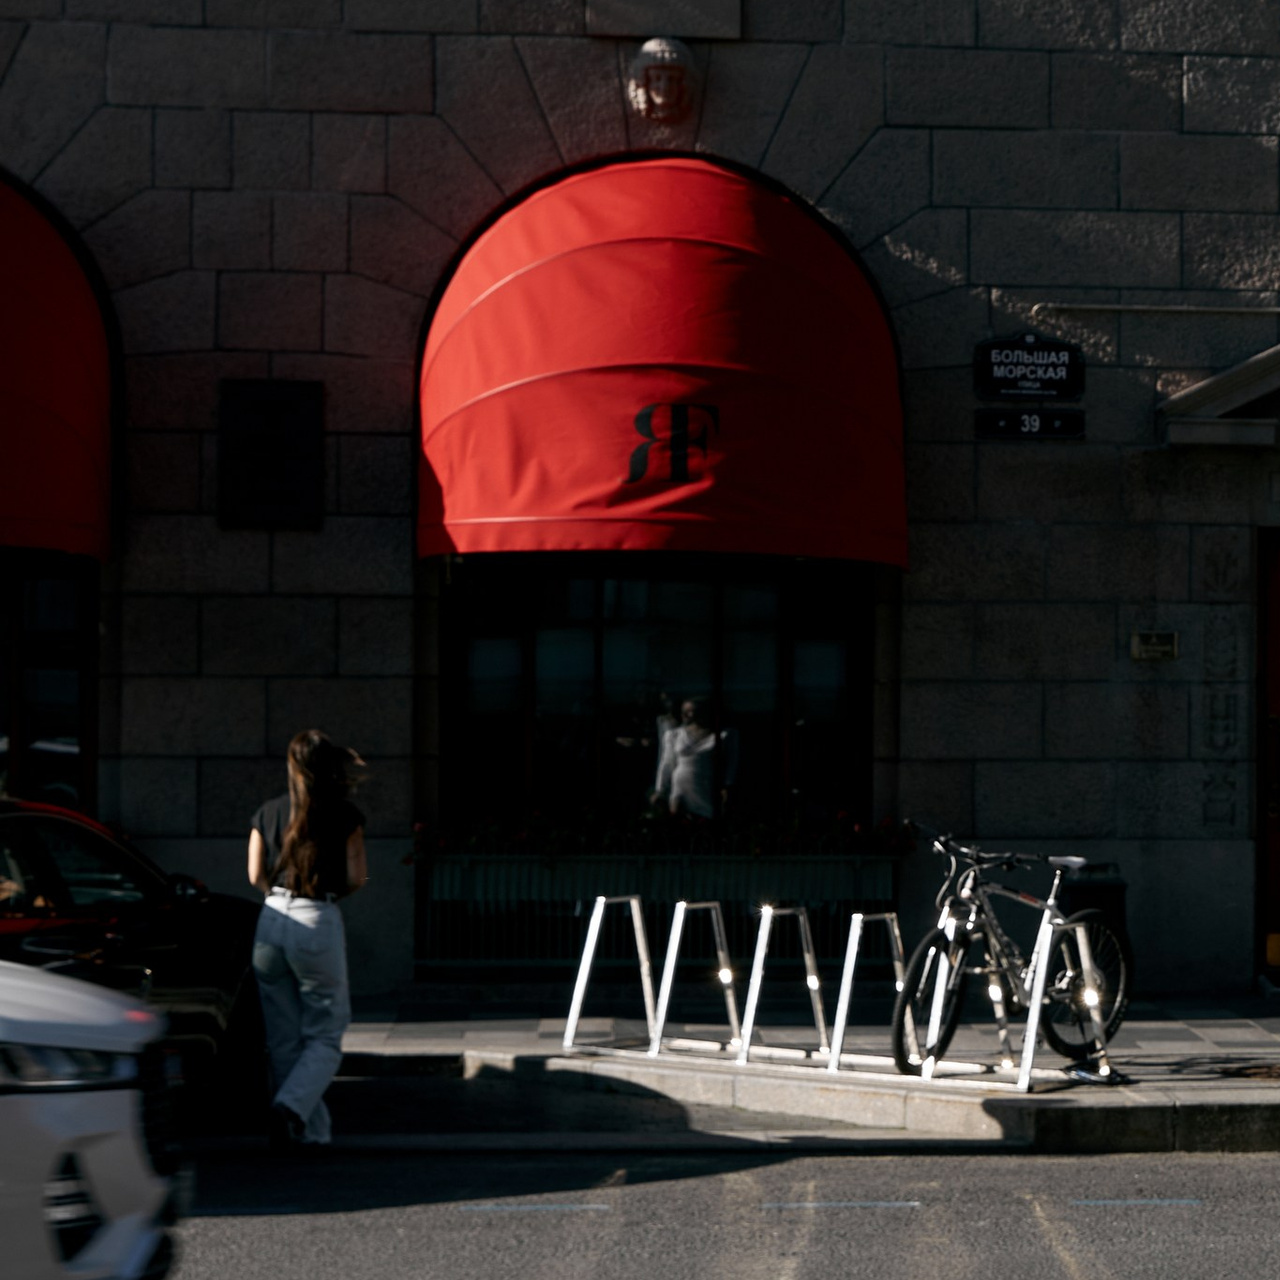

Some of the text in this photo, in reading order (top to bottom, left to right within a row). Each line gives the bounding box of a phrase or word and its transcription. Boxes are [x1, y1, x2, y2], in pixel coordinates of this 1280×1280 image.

[990, 349, 1070, 365] БОЛЬШАЯ
[993, 365, 1067, 380] МОРСКАЯ
[1020, 414, 1041, 433] 39
